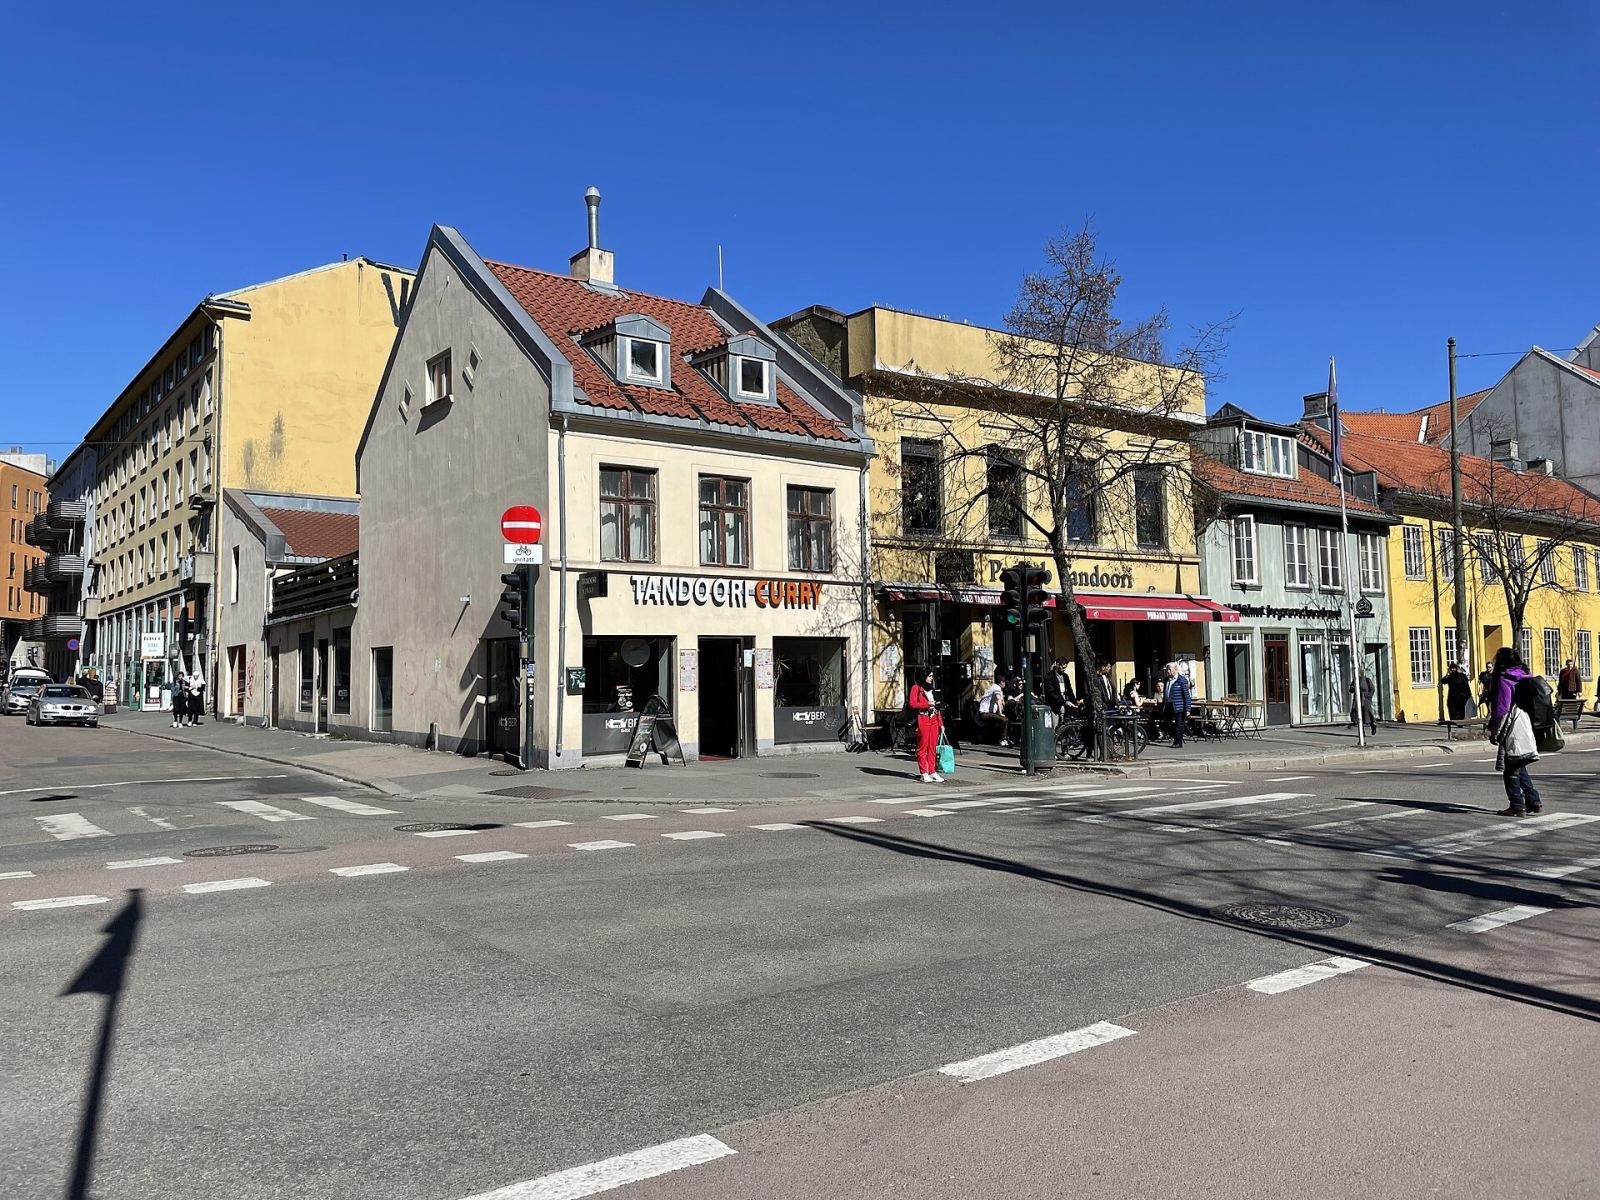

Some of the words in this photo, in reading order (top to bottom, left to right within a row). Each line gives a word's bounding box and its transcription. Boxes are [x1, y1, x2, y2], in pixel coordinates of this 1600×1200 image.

[630, 575, 750, 606] TANDOORI
[754, 578, 823, 607] CURRY
[1071, 565, 1132, 589] andoori
